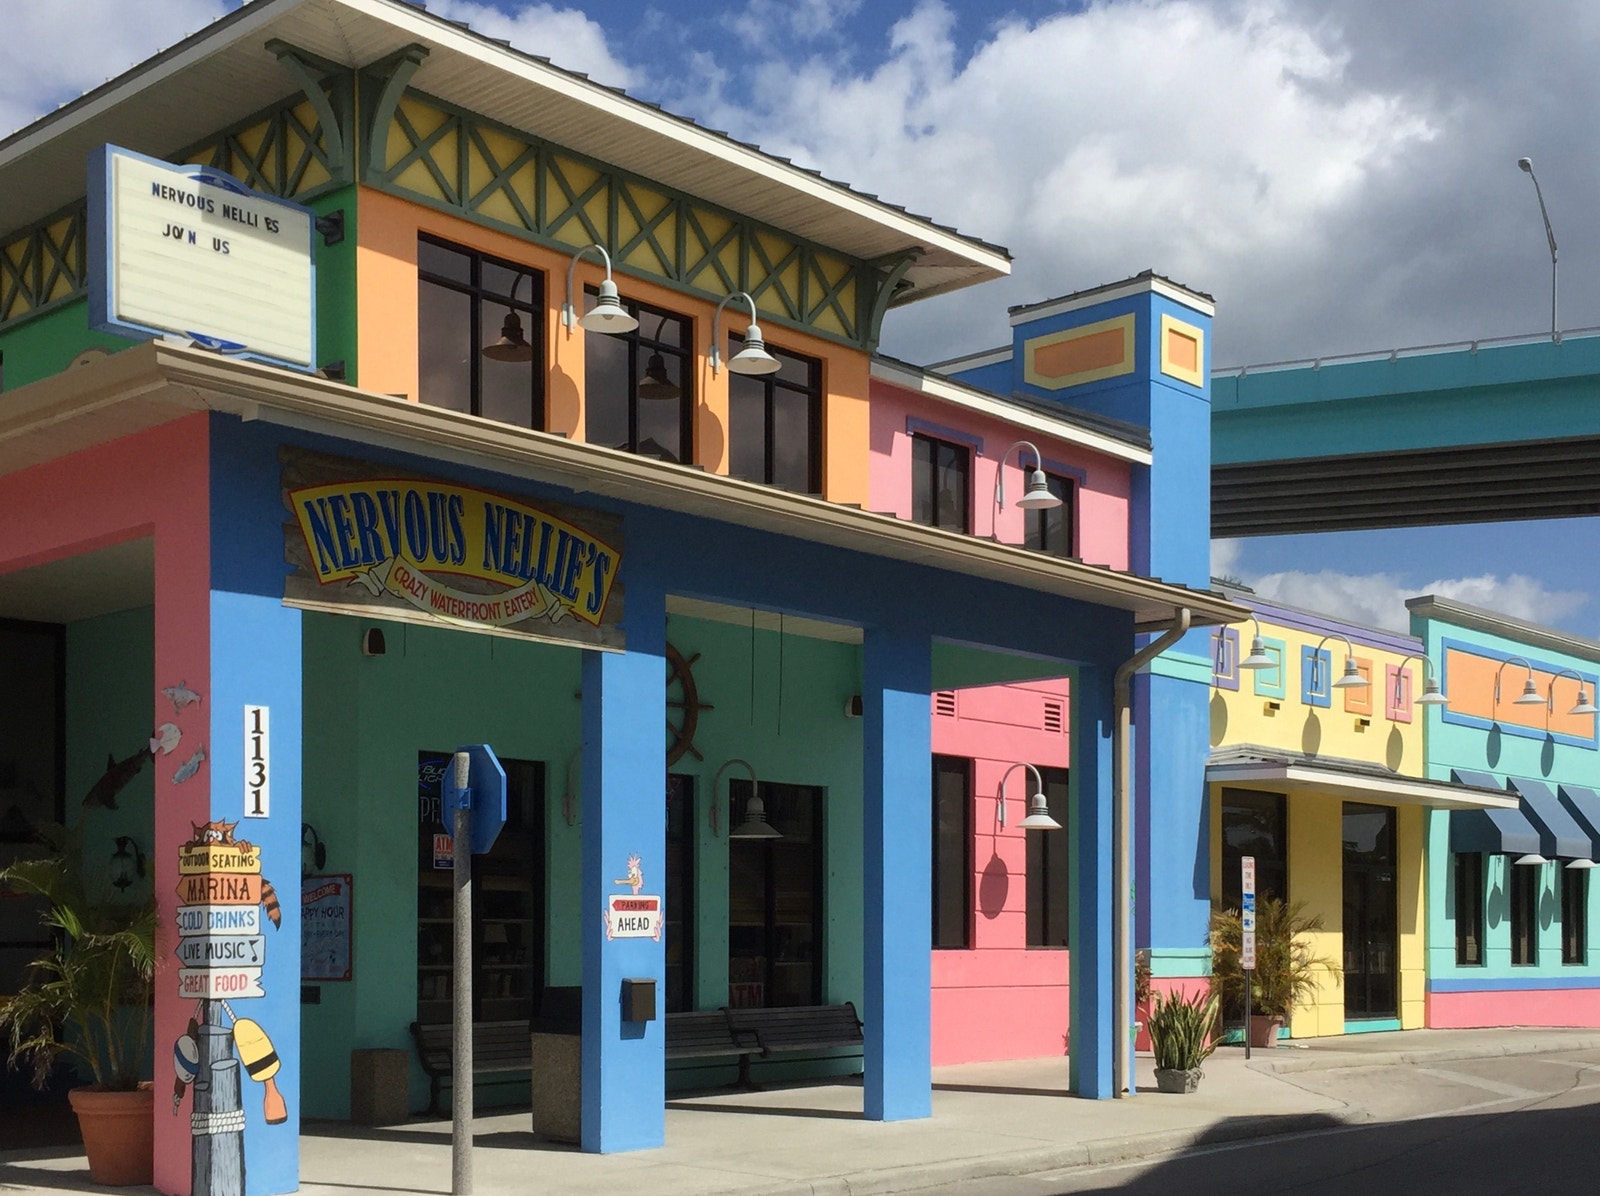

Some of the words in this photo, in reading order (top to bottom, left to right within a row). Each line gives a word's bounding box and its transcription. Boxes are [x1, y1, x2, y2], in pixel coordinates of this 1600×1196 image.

[152, 181, 215, 213] NERVOUS
[213, 237, 230, 254] US
[303, 489, 464, 575] NERVOUS
[483, 501, 610, 615] NELLIE'S
[393, 566, 429, 605] CRAZY
[430, 591, 502, 621] WATERFRONT
[503, 588, 540, 618] EATERY
[248, 708, 267, 816] 1131
[182, 852, 210, 867] OUTDOOR
[211, 853, 255, 868] SEATING
[186, 877, 251, 901] MARINA
[302, 883, 337, 904] WELCOME
[321, 904, 345, 920] HOUR
[621, 900, 650, 910] PARKING
[182, 909, 203, 930] COLD
[207, 909, 255, 928] DRINKS
[617, 917, 650, 932] AHEAD
[183, 941, 201, 960] LIVE
[204, 940, 246, 960] MUSIC
[184, 974, 210, 993] GREAT
[214, 973, 249, 993] FOOD
